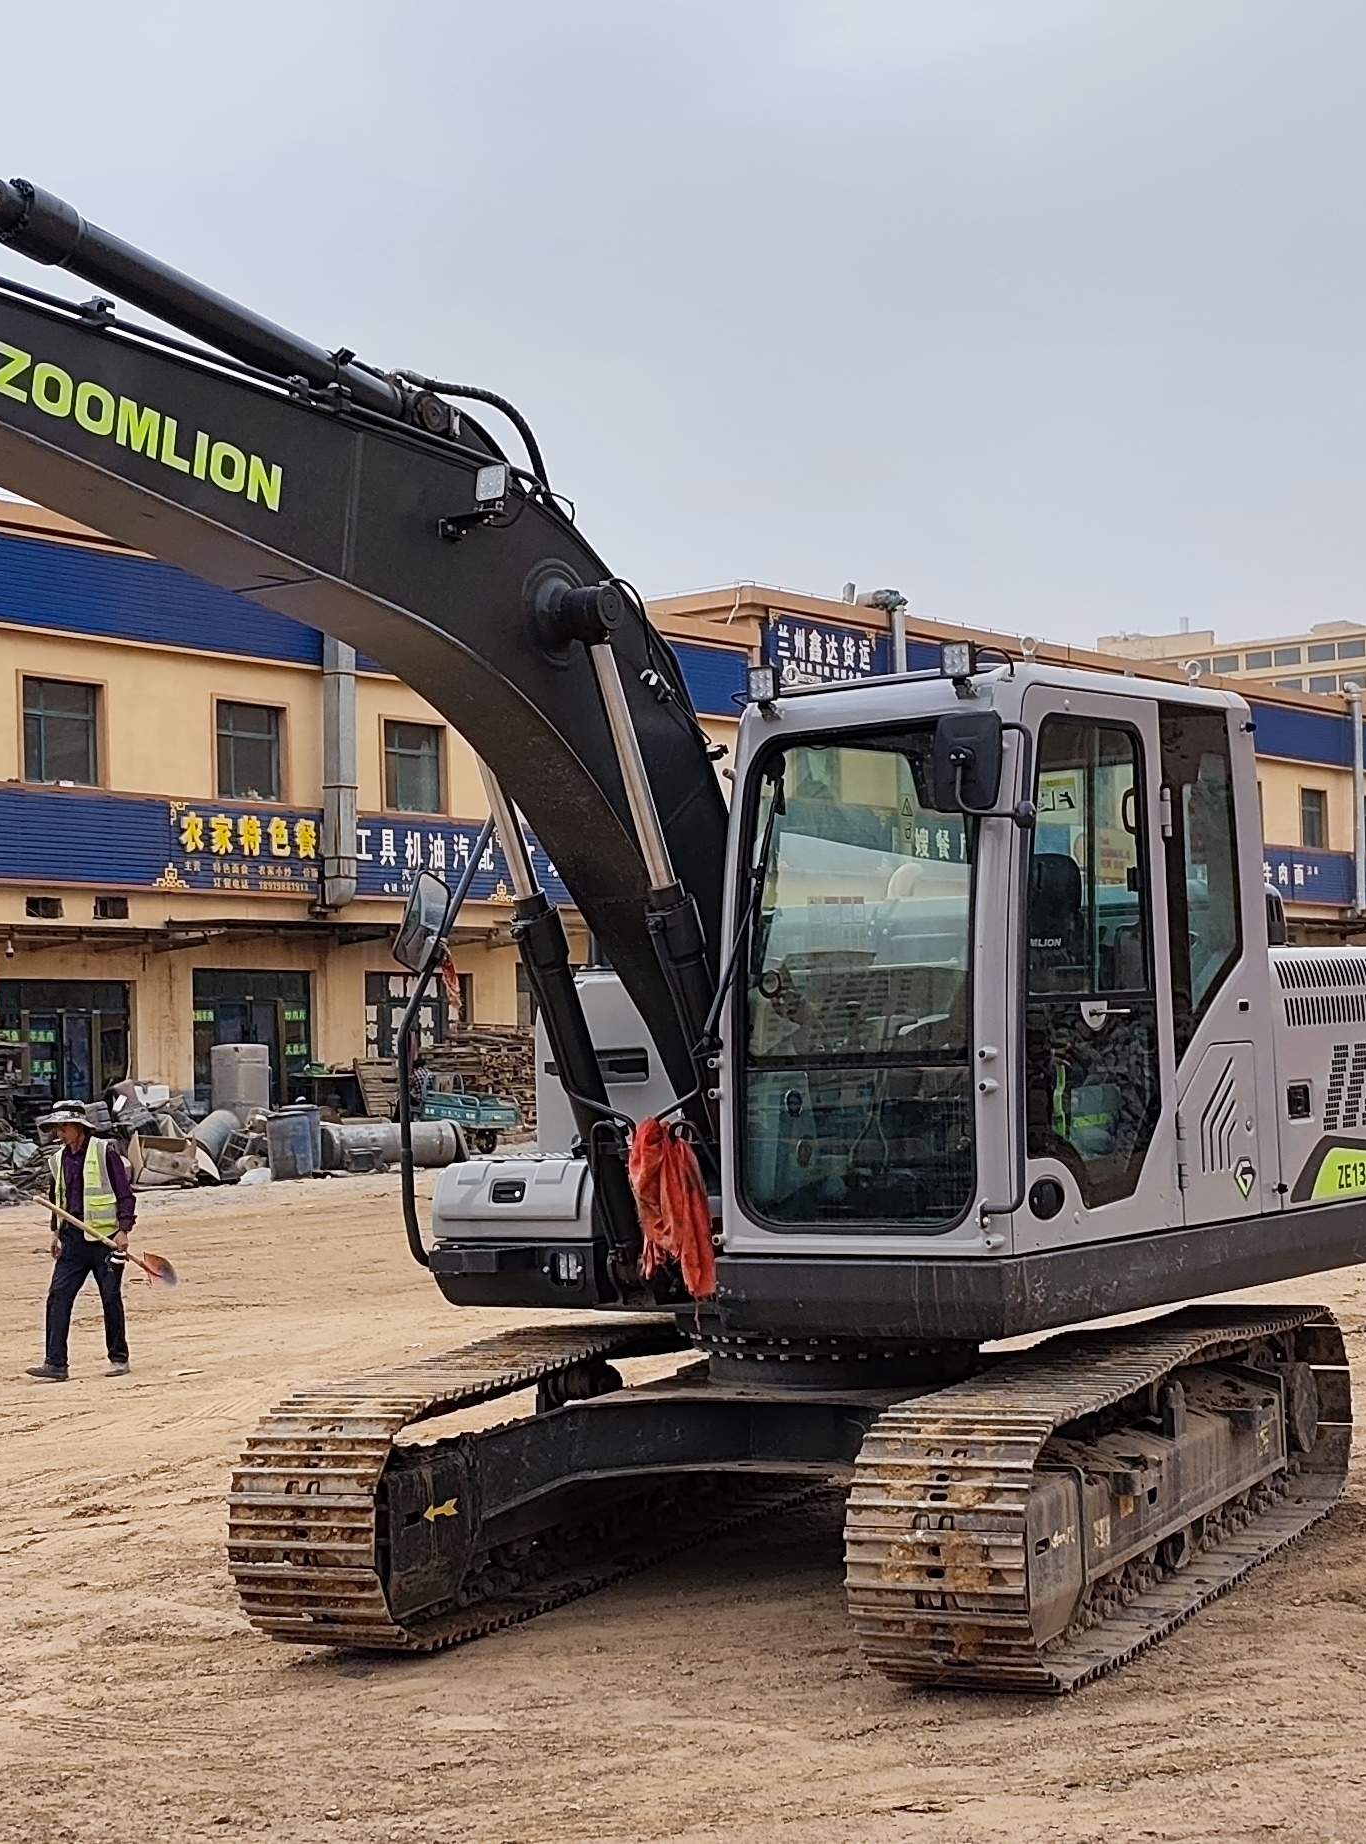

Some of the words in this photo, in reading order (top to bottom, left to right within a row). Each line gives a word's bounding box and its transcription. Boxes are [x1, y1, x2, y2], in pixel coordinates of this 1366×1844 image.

[777, 623, 871, 671] 兰州鑫达货运
[178, 811, 323, 859] 农家特色餐
